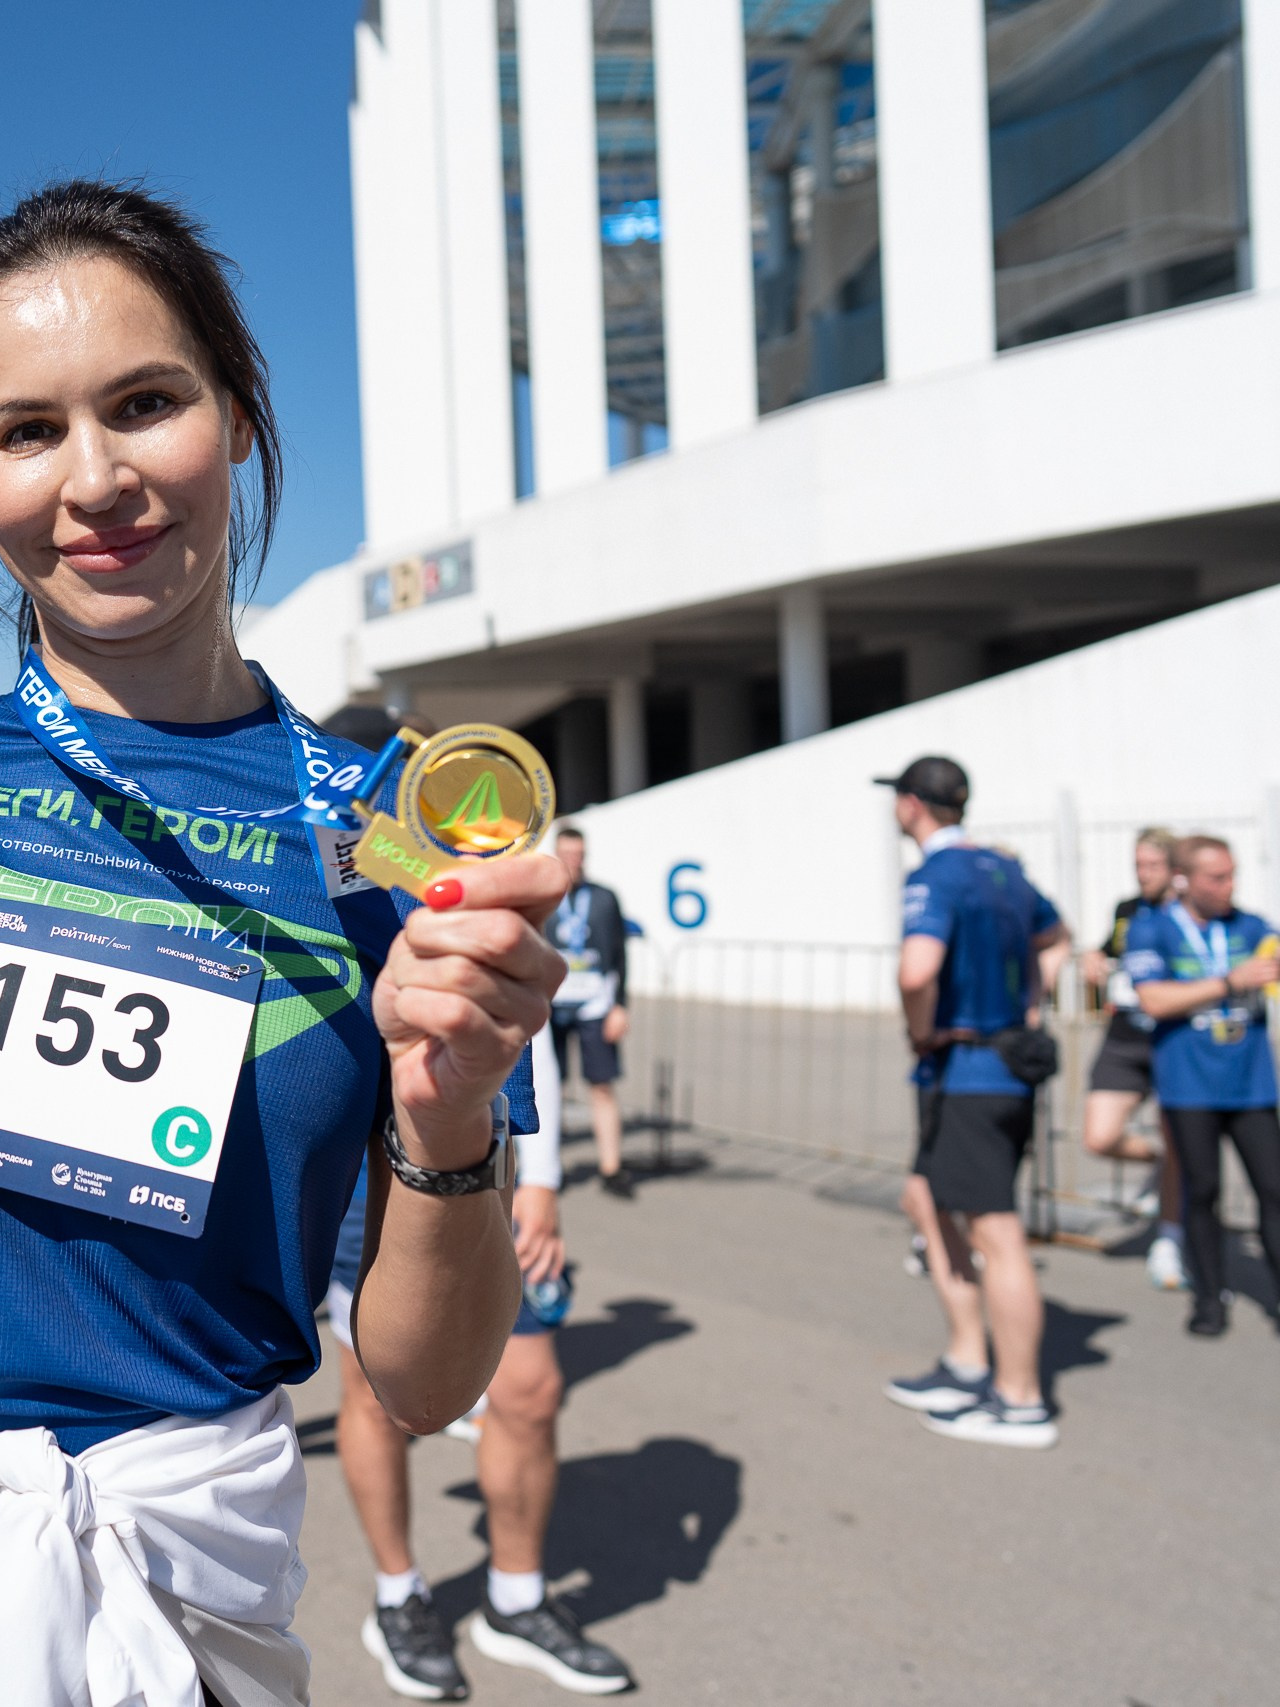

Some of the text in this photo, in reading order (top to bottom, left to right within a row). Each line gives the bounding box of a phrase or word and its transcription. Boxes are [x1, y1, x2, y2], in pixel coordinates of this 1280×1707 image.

[17, 666, 78, 738] ГЕРОИ
[328, 764, 366, 792] 10
[89, 794, 280, 865] ГЕРОЙ!
[143, 863, 270, 895] ПОЛУМАРАФОН
[668, 863, 706, 928] 6
[156, 945, 195, 962] НИЖНИЙ
[89, 1186, 106, 1197] 2024
[150, 1191, 186, 1213] ПСБ
